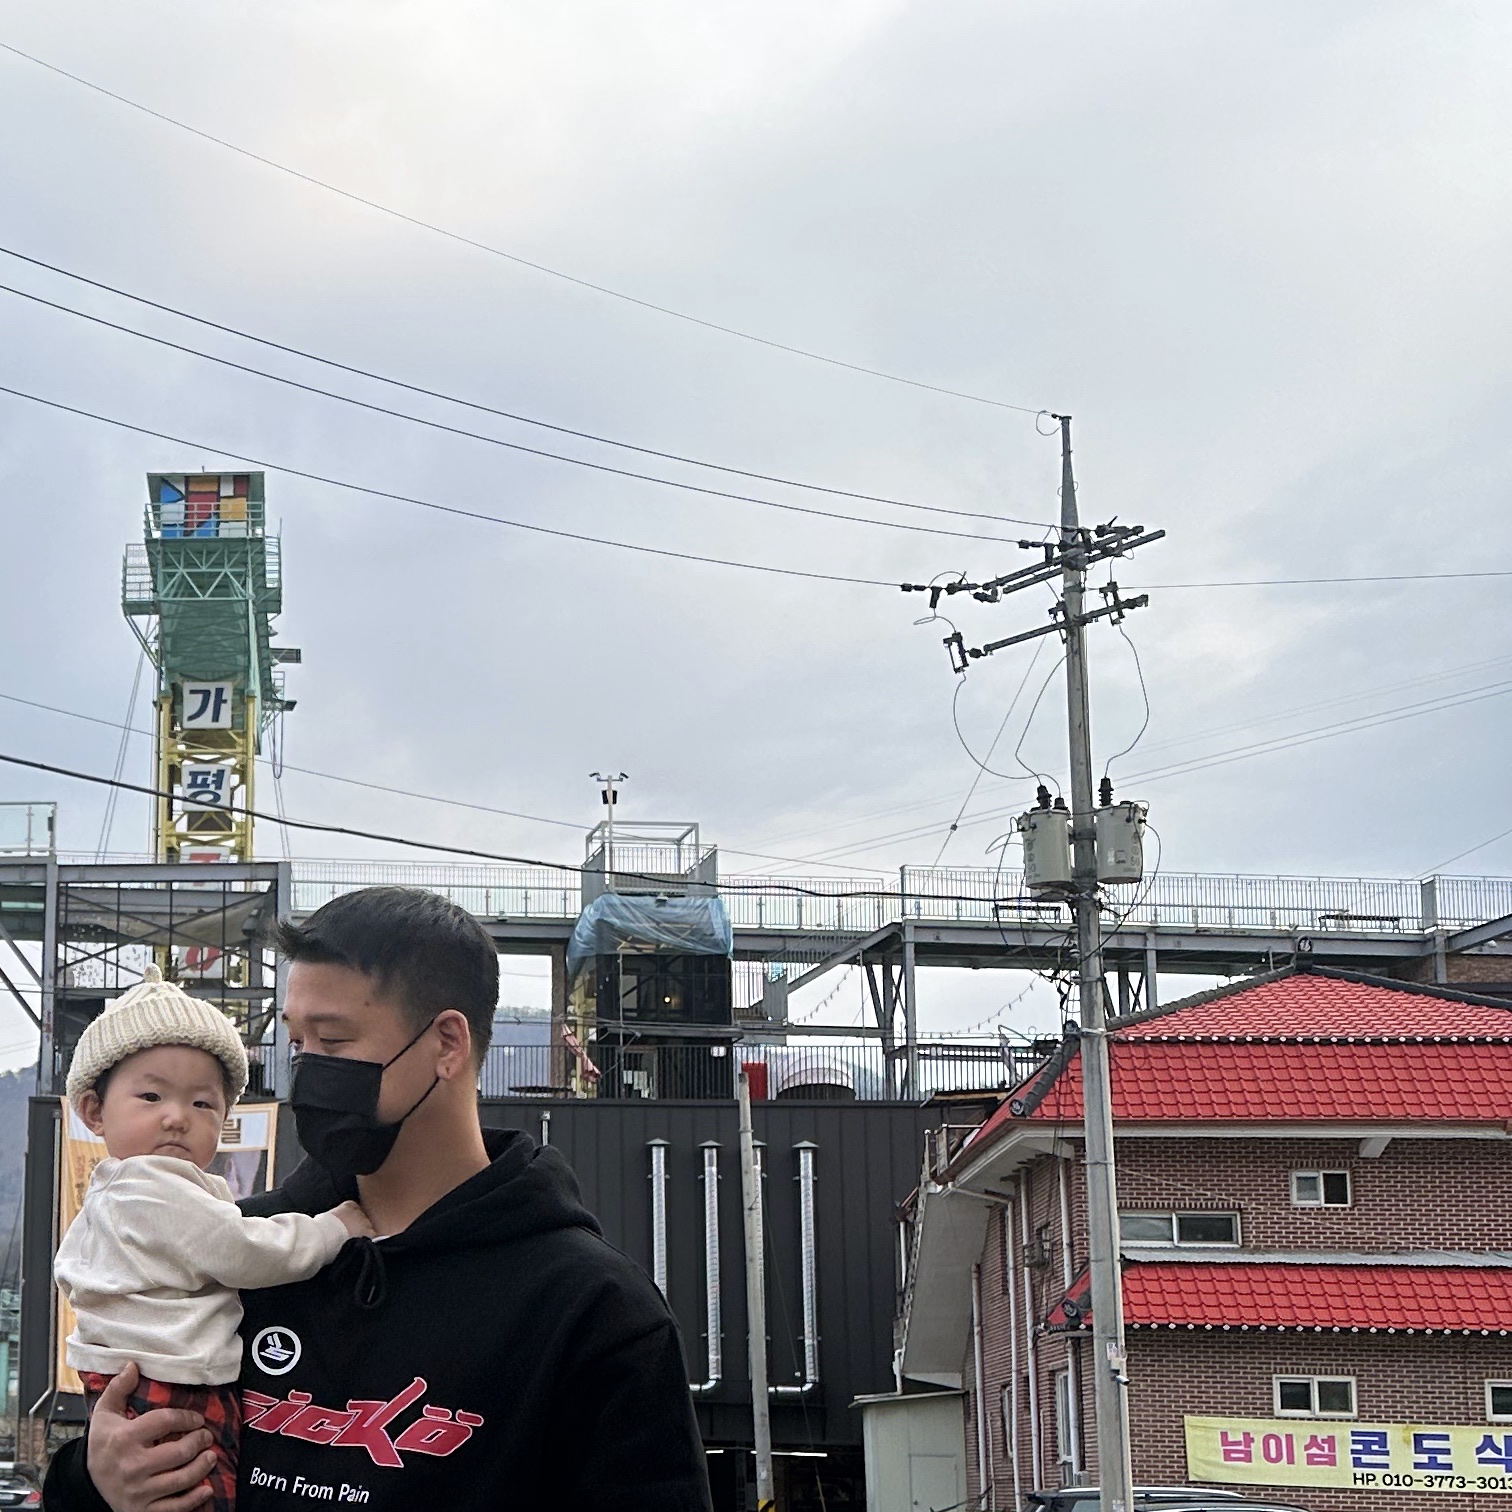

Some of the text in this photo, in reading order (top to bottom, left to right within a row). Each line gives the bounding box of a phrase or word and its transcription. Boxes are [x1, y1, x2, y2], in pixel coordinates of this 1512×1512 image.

[1219, 1431, 1337, 1467] 남이섬
[250, 1467, 370, 1504] Born From Pain
